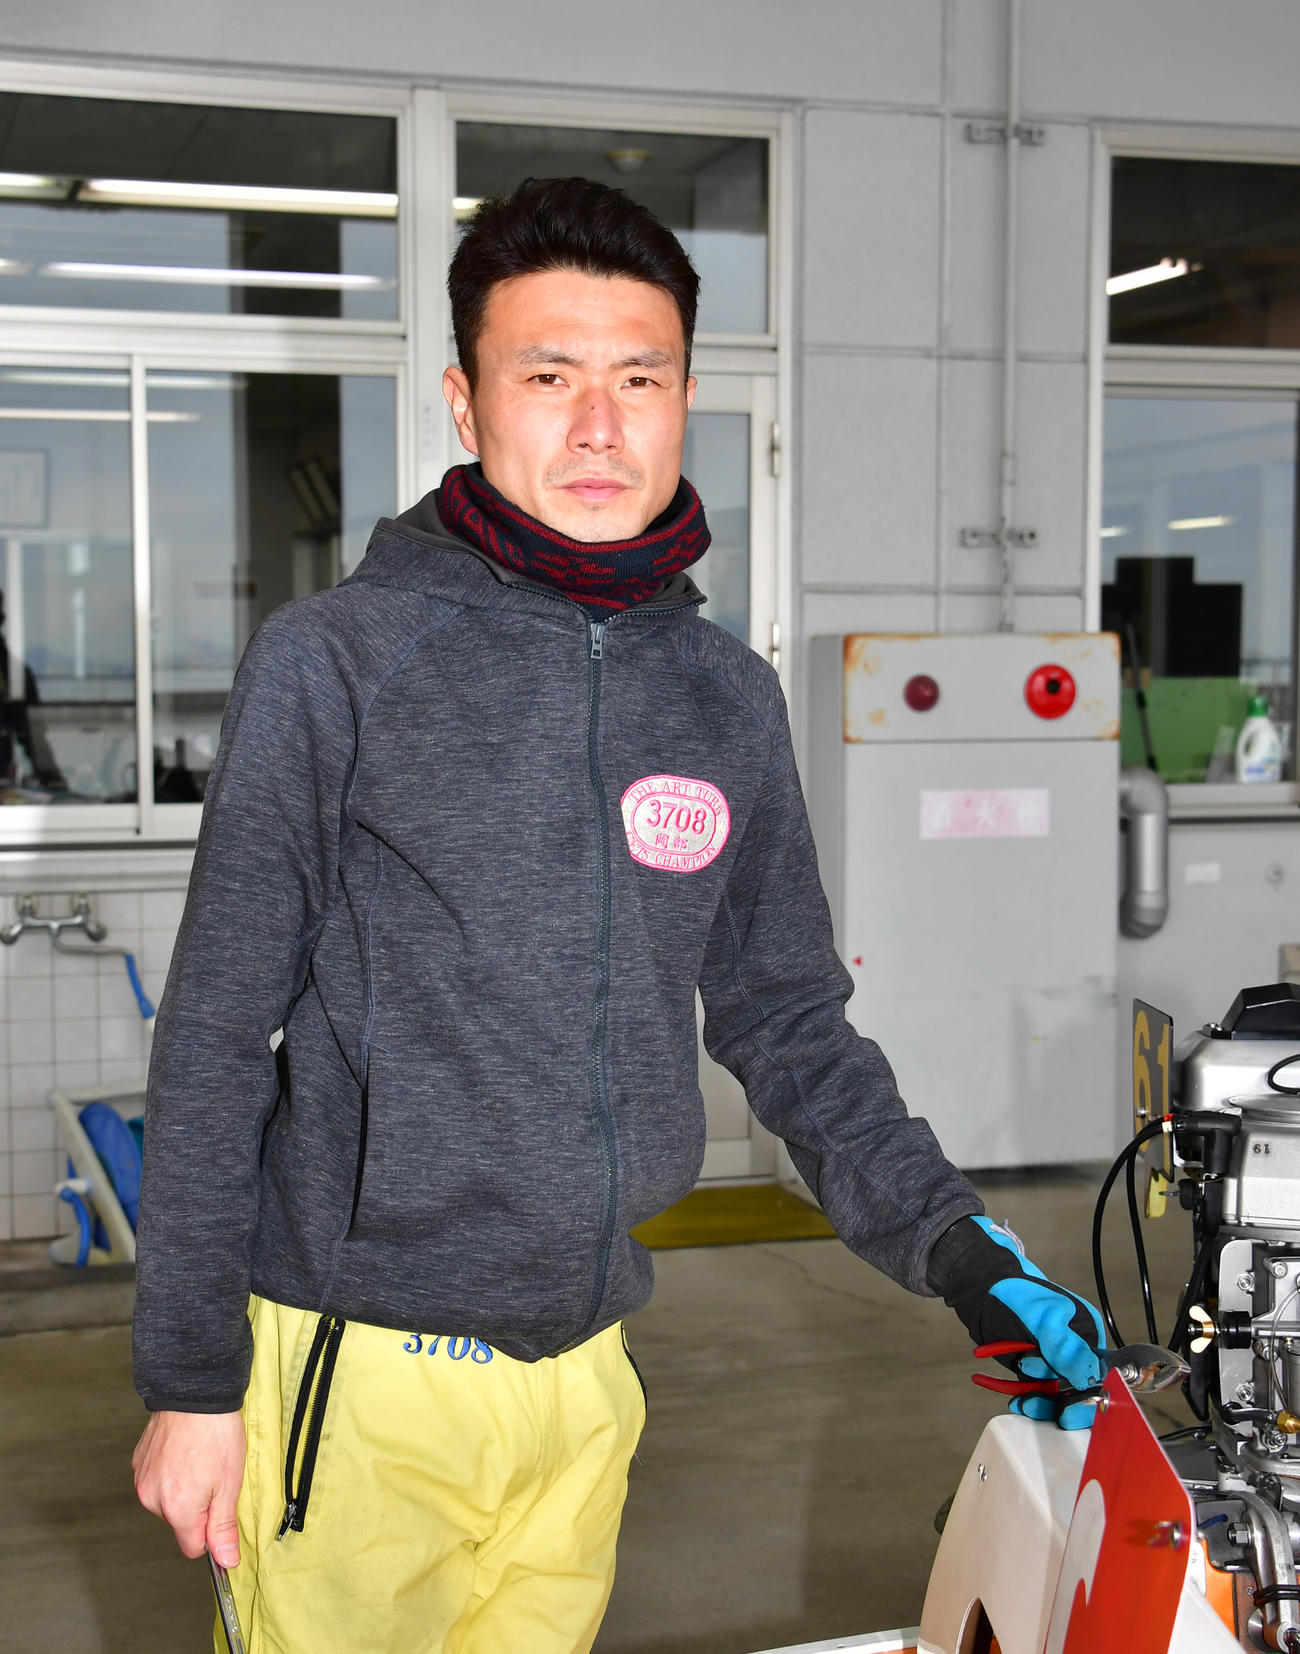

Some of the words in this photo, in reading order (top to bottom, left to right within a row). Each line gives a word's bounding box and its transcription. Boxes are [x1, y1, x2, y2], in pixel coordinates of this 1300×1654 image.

[628, 782, 656, 802] THE
[662, 780, 691, 795] ART
[646, 799, 707, 834] 3708
[1133, 1010, 1170, 1174] 61
